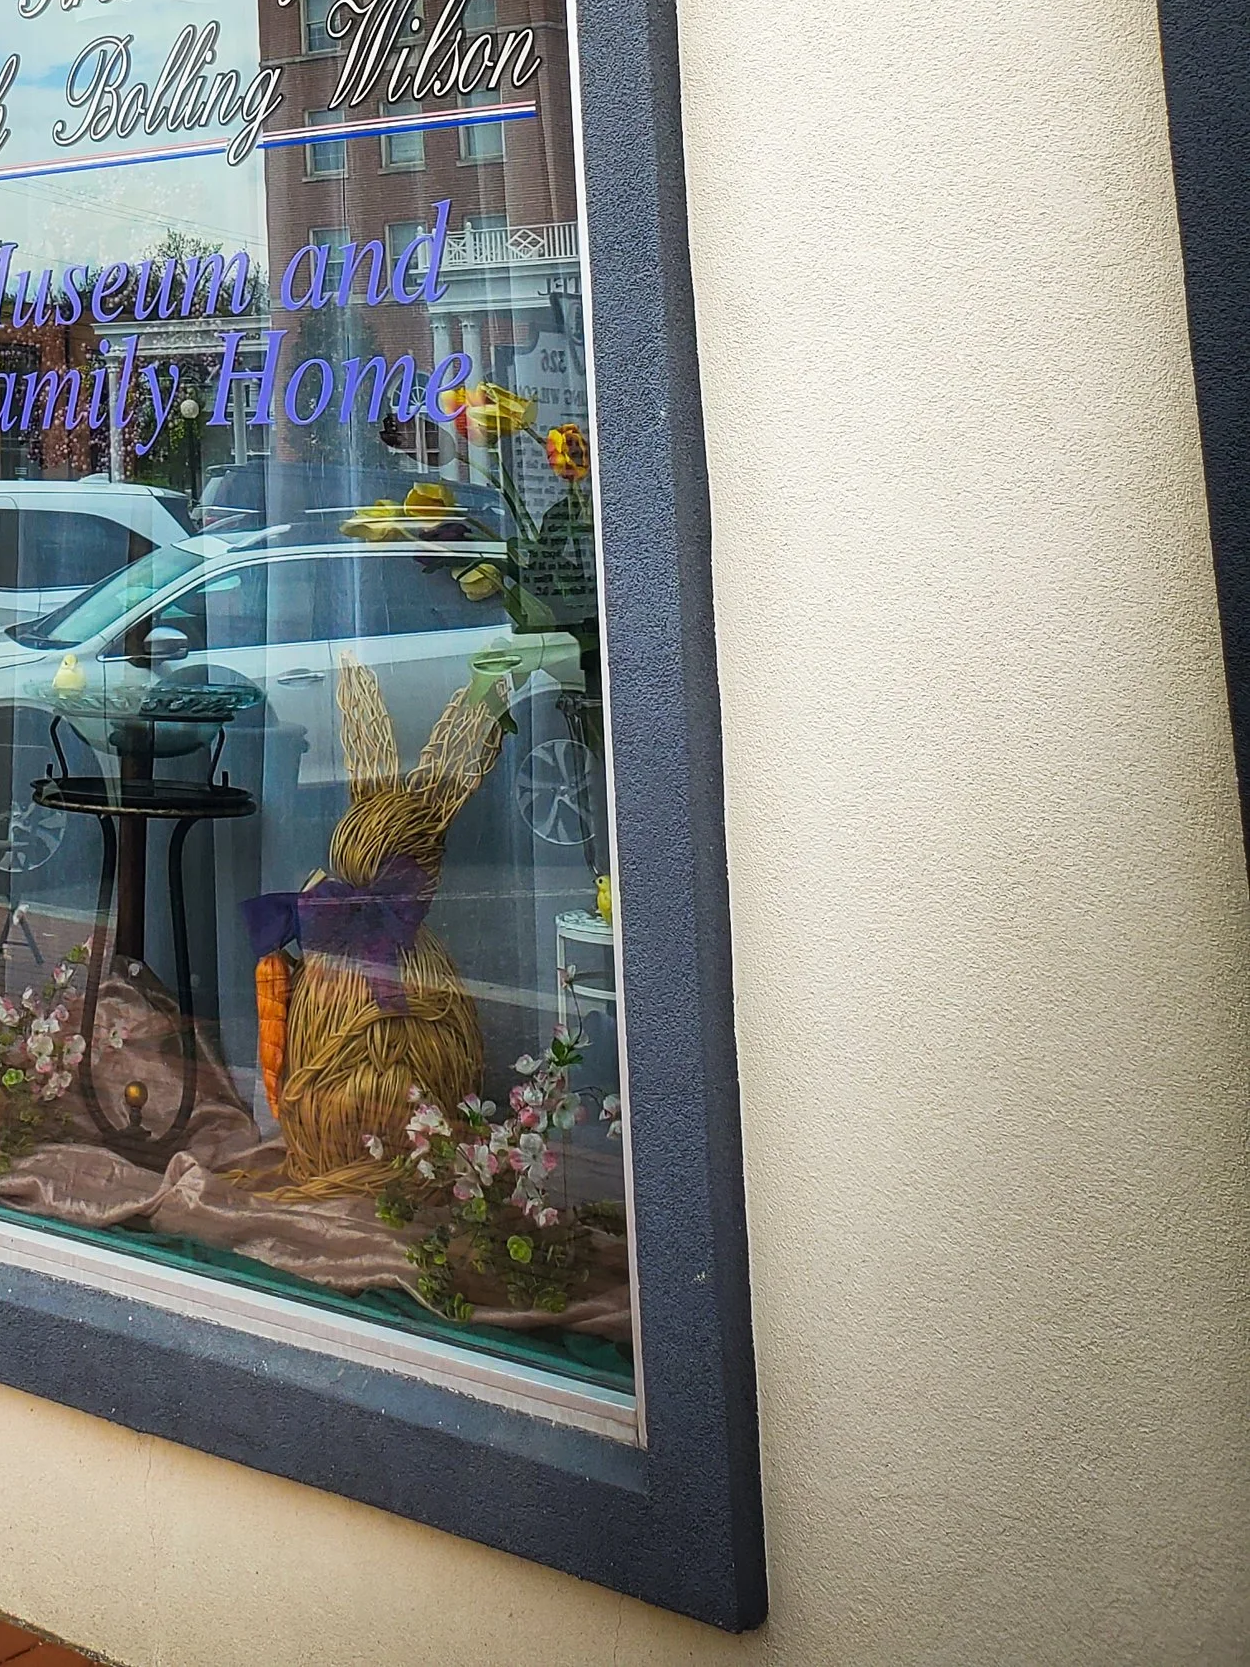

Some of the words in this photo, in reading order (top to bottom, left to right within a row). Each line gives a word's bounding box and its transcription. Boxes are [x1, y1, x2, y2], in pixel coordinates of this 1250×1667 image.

[52, 20, 283, 167] Bolling
[280, 198, 452, 310] and
[206, 329, 473, 428] Home
